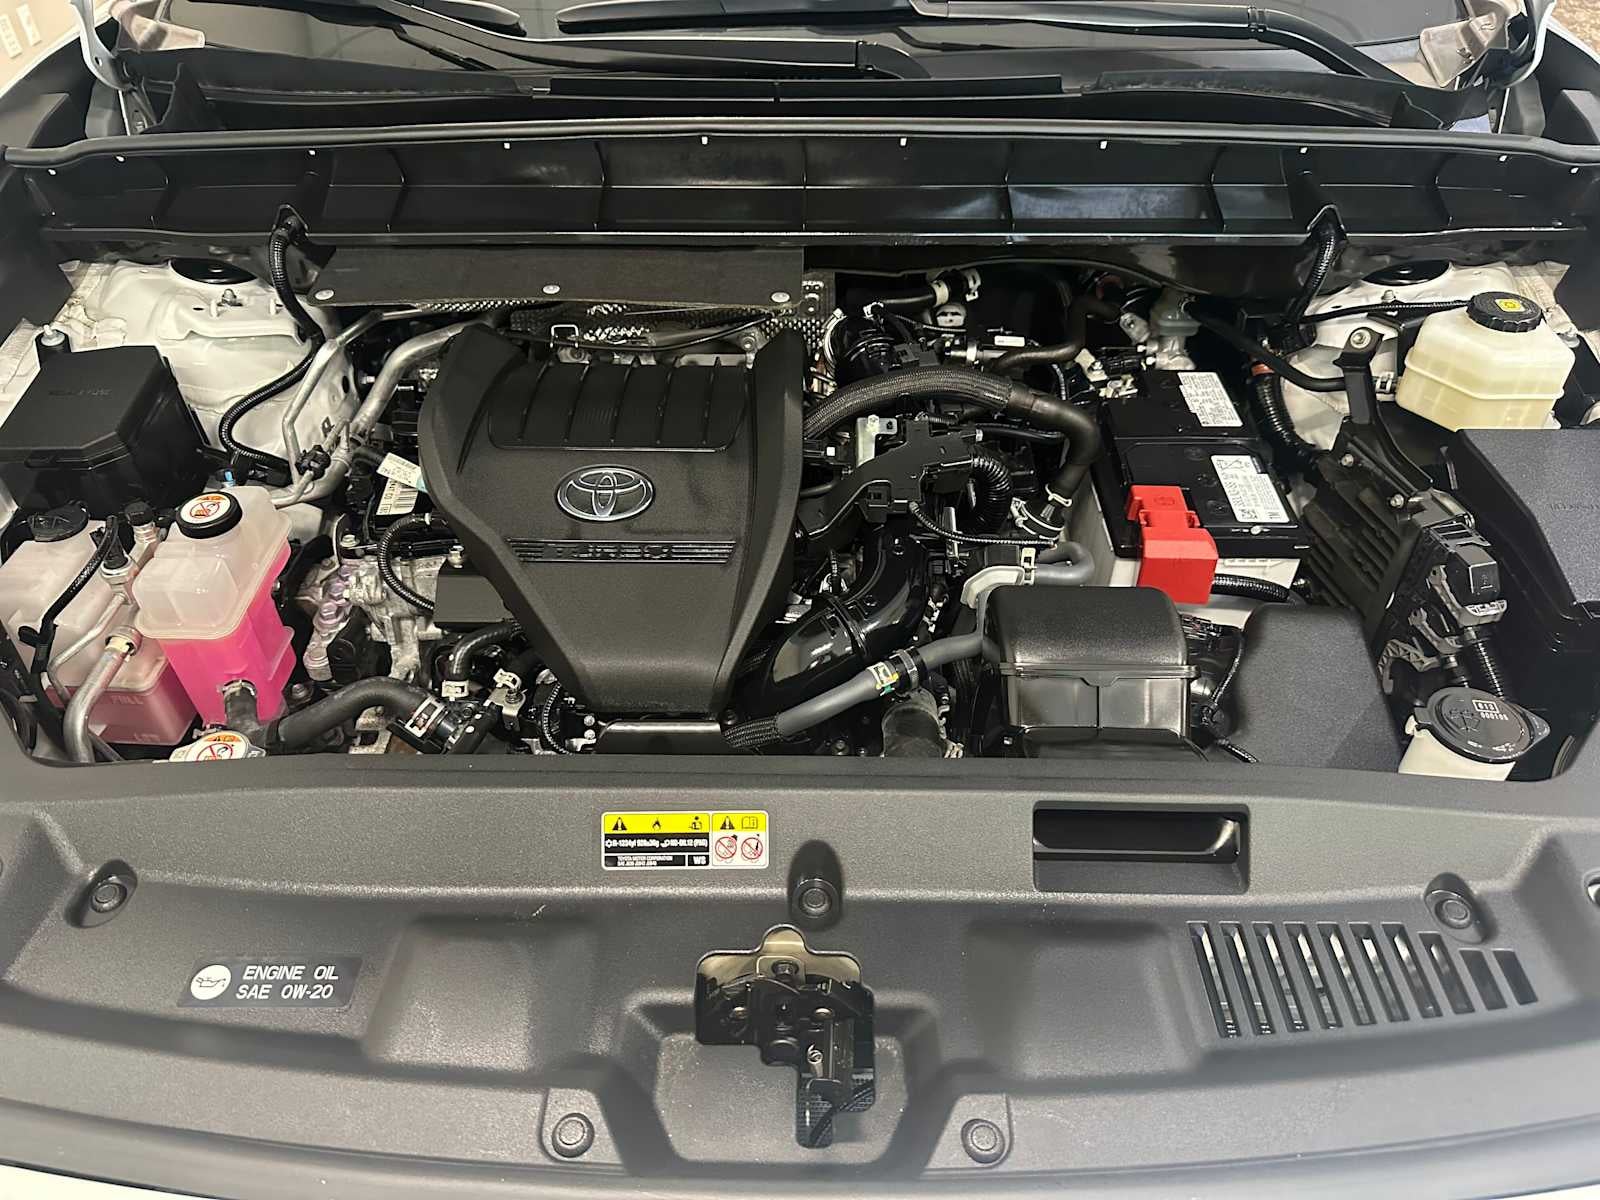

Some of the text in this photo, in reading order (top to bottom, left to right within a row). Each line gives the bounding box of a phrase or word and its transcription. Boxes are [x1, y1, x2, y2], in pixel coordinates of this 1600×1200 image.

[242, 965, 339, 980] ENGINE OIL
[235, 984, 334, 1000] SAE 0W-20
